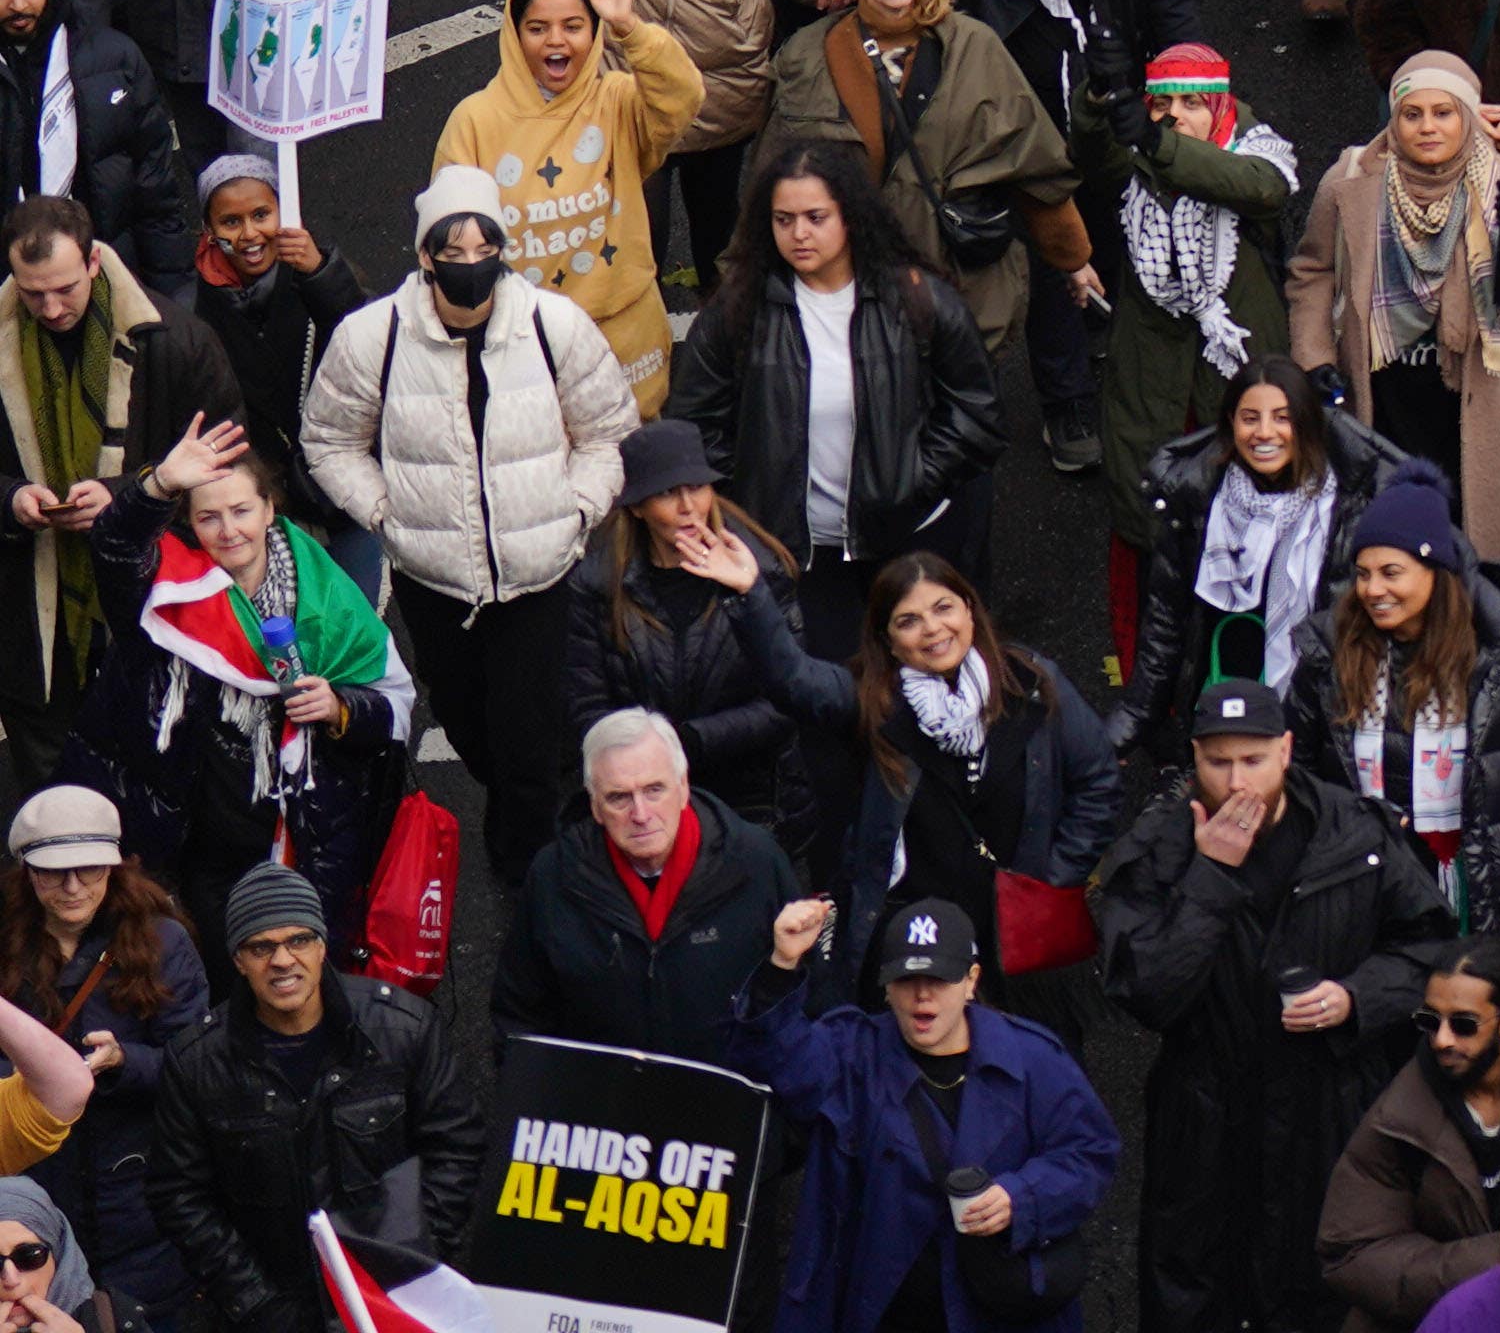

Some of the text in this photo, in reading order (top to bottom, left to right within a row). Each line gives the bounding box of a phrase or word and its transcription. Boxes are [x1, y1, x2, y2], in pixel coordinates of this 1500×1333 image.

[533, 185, 609, 219] much
[513, 1118, 735, 1191] HANDS OFF
[498, 1162, 729, 1246] AL-AQSA
